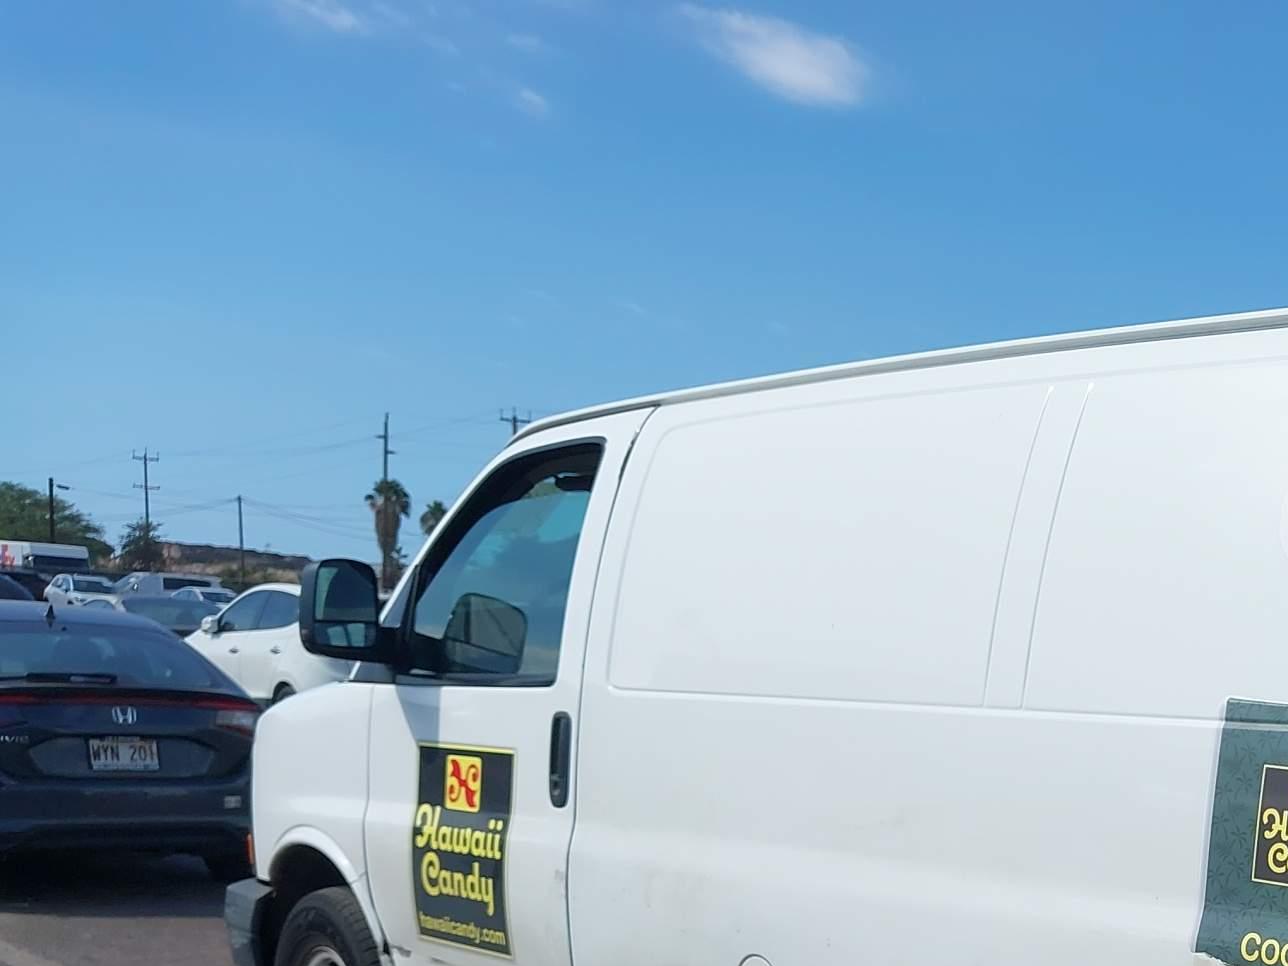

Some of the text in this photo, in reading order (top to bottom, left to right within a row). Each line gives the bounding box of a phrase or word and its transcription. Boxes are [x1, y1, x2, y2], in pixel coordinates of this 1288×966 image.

[91, 744, 120, 761] WYN
[415, 803, 504, 860] Hawaii
[421, 851, 494, 916] Candy
